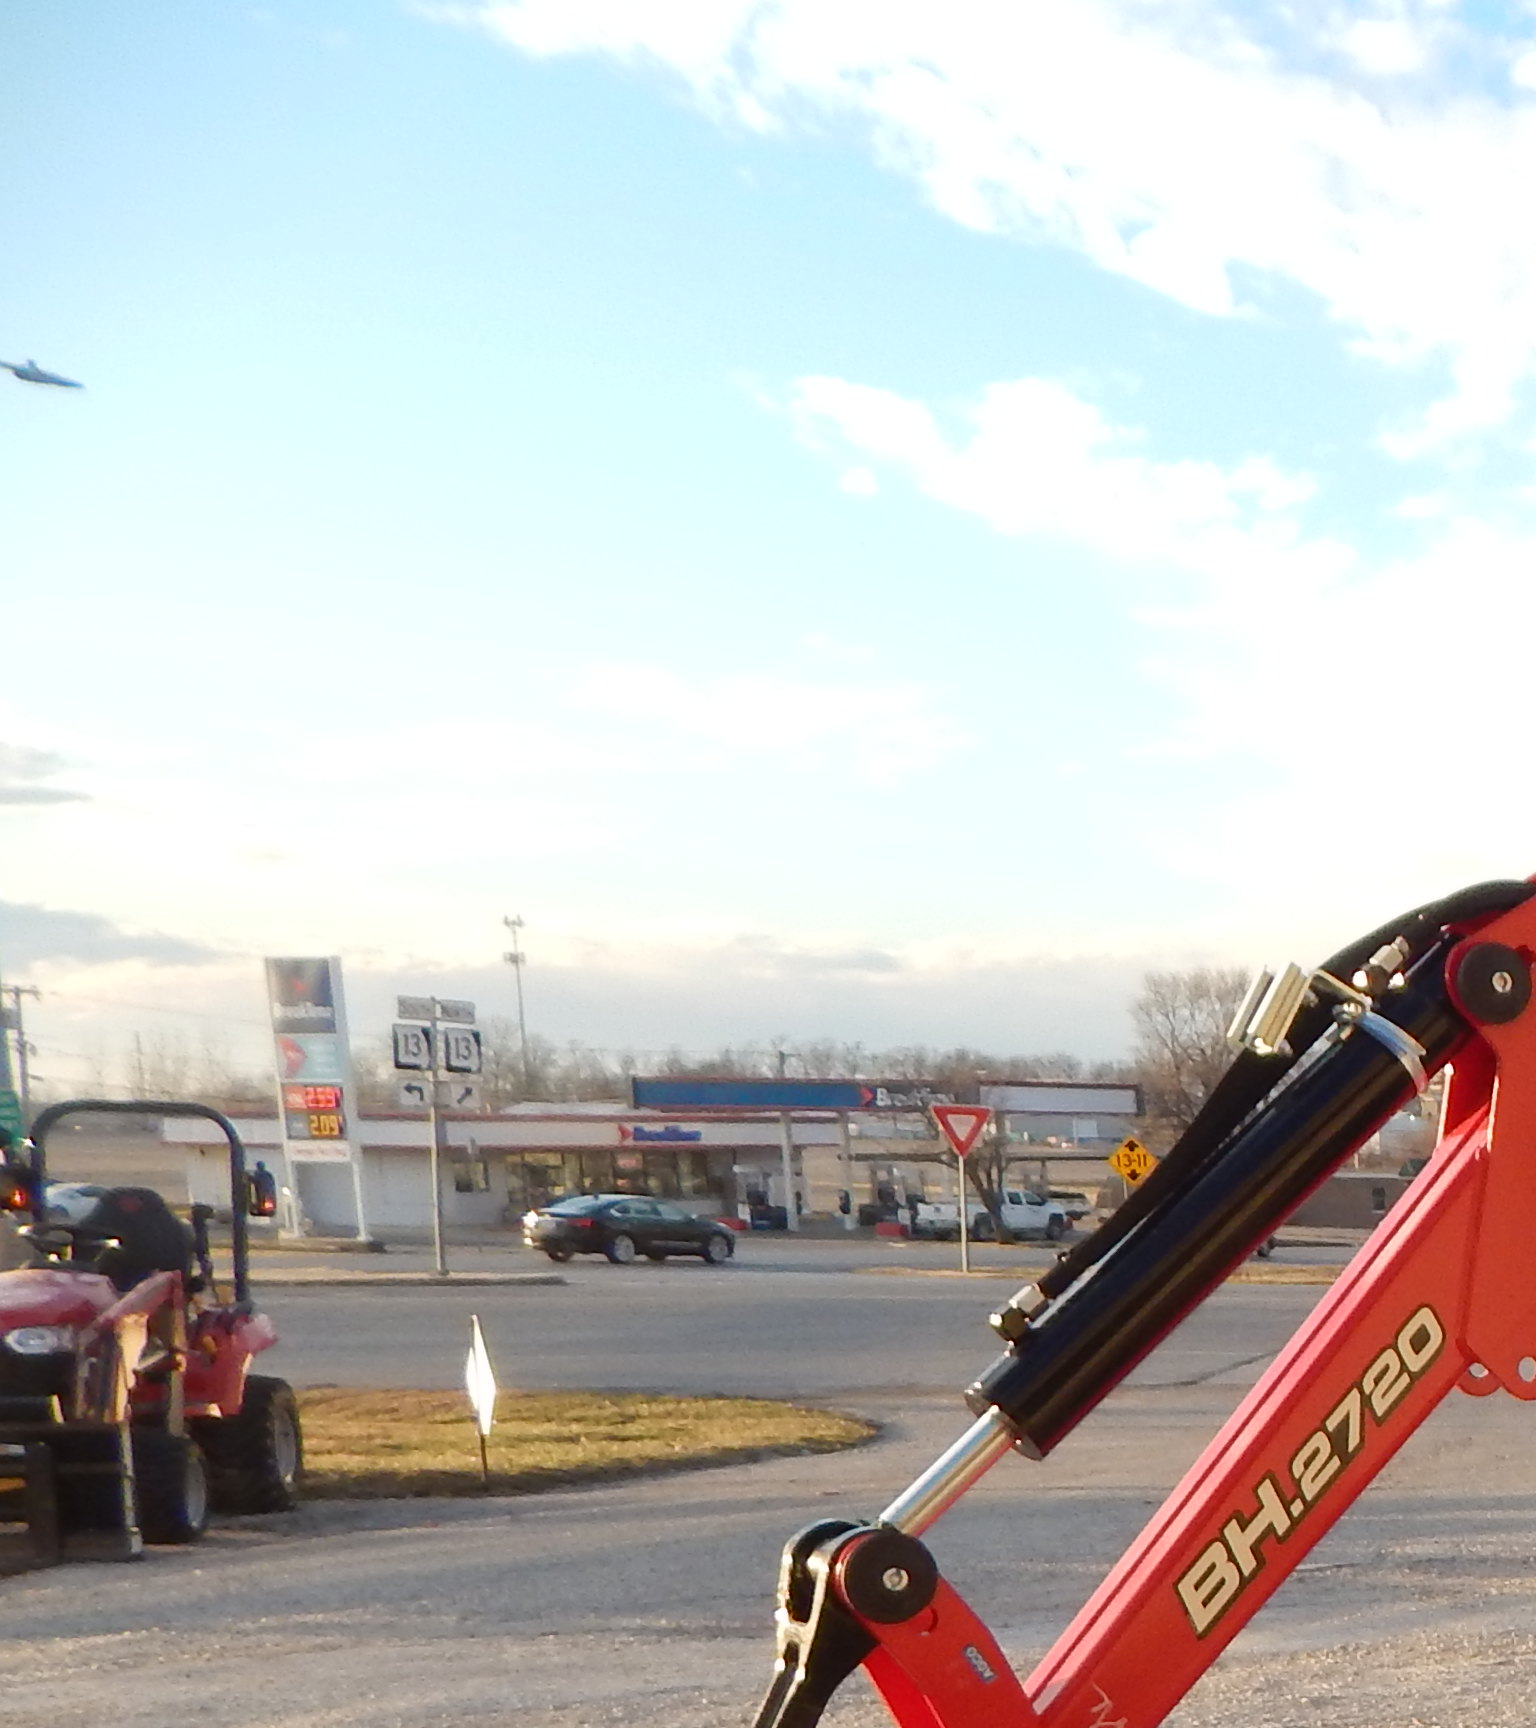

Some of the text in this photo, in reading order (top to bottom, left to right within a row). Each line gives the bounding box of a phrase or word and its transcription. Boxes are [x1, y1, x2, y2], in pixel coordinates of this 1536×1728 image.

[403, 1033, 422, 1057] 13
[454, 1036, 472, 1061] 13
[1116, 1153, 1147, 1168] 13-11
[1174, 1303, 1445, 1639] BH.2720
